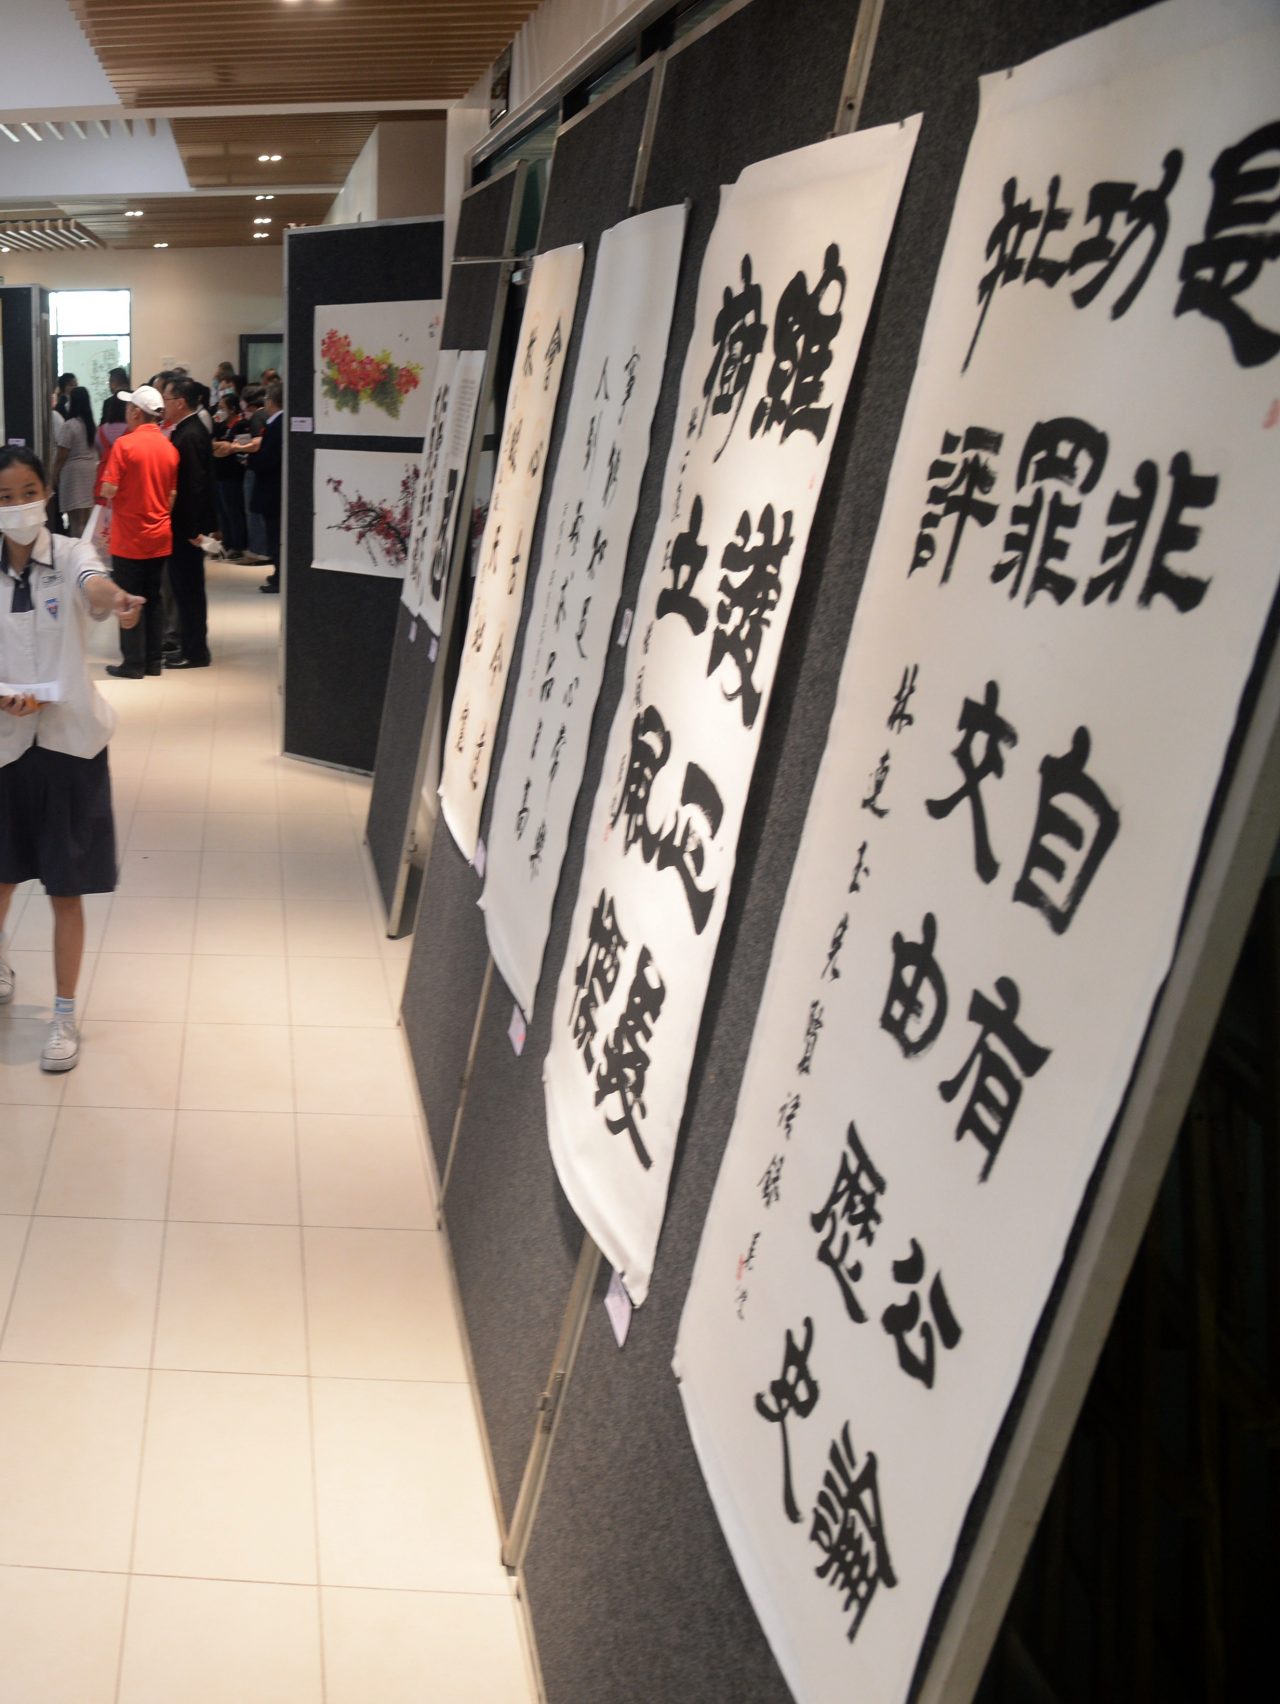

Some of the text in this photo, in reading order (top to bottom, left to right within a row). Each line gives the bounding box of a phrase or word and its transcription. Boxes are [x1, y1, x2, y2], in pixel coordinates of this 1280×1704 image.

[594, 241, 848, 1172] 維護正義
[756, 148, 1184, 1524] 功罪交由歷史
